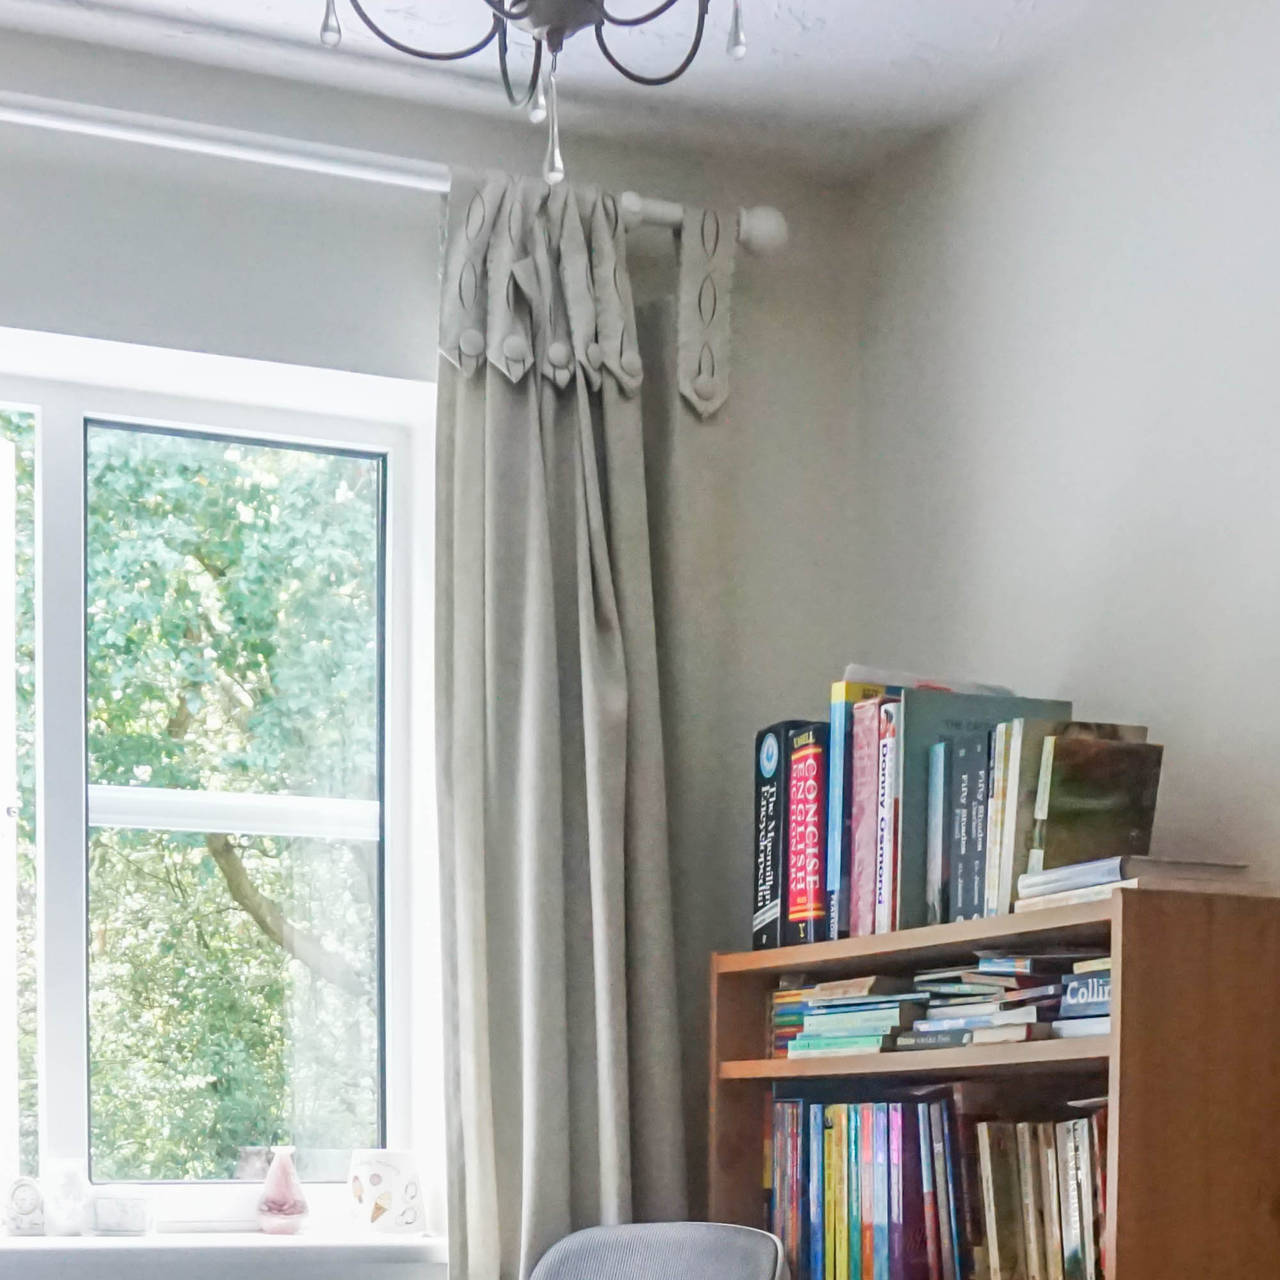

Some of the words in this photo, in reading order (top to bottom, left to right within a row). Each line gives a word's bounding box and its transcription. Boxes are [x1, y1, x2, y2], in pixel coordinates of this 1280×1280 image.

[768, 781, 777, 816] The
[879, 744, 888, 808] Donny
[960, 773, 969, 805] Fifty
[976, 770, 985, 801] Fifty
[757, 785, 771, 906] Encyclopedia
[765, 819, 776, 905] Macmillan
[790, 763, 798, 890] DICTIONARY
[797, 762, 806, 890] ENGLISH
[805, 758, 821, 889] CONCISE
[877, 816, 886, 905] Osmond
